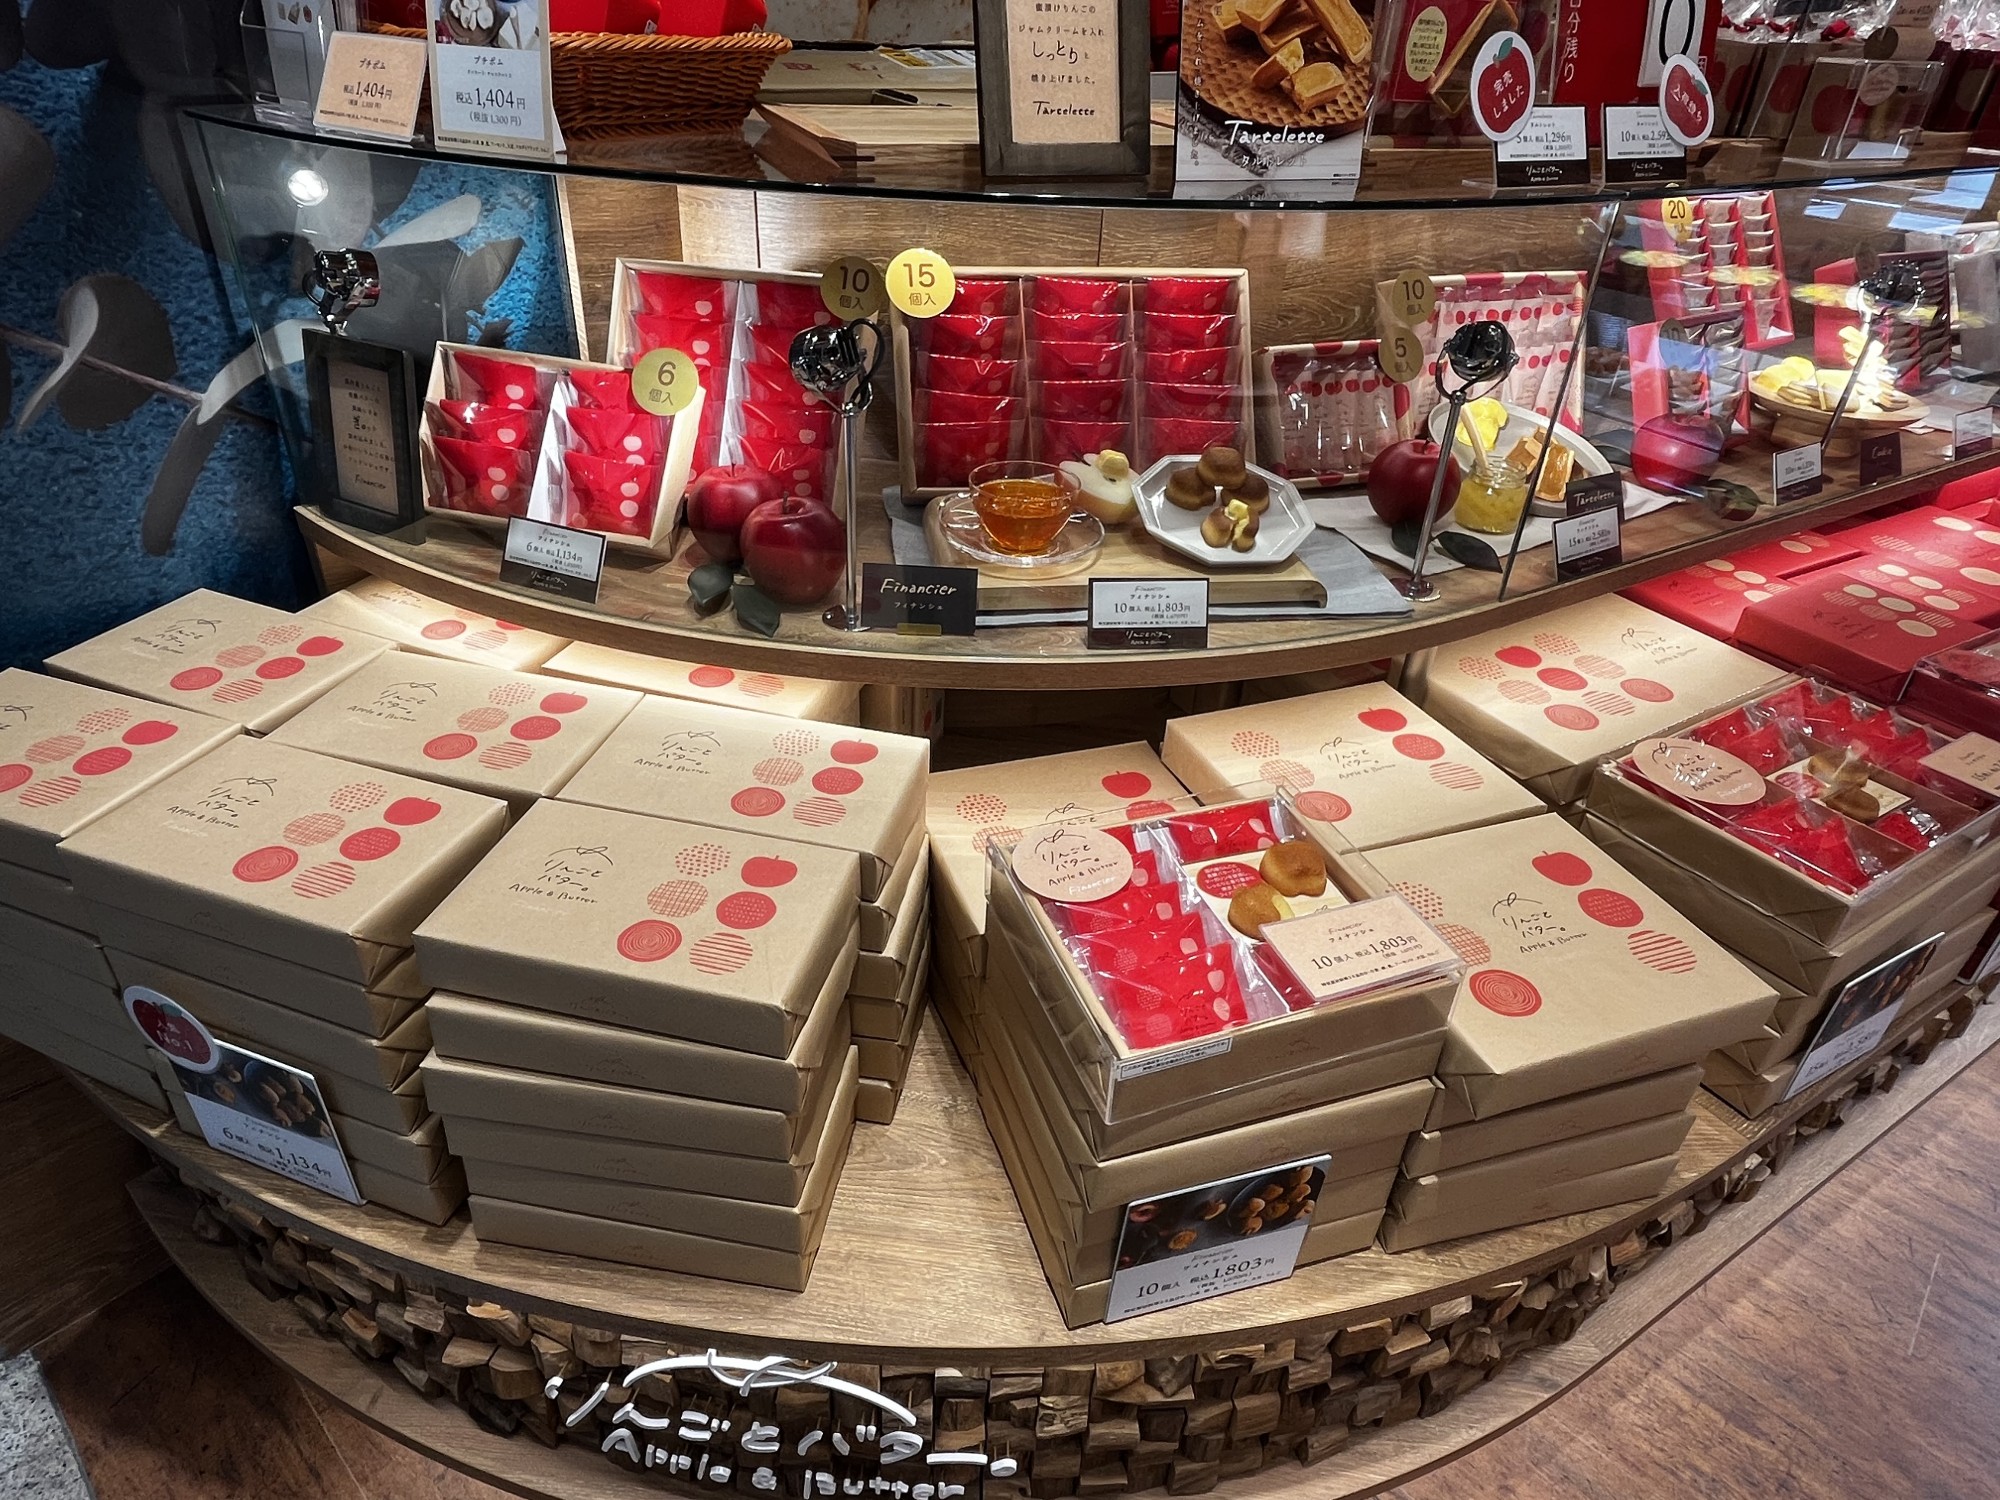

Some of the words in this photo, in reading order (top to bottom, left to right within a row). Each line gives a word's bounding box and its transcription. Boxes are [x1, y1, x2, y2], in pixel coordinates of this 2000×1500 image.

[1493, 70, 1513, 96] 完売
[1493, 85, 1525, 118] しました
[1225, 119, 1325, 146] Tartelette
[1668, 200, 1686, 219] 20
[839, 265, 870, 293] 10
[902, 263, 935, 288] 15
[908, 291, 937, 307] 個入
[1403, 279, 1425, 300] 10
[839, 294, 864, 311] 個入
[1394, 337, 1407, 358] 5
[656, 361, 676, 387] 6
[648, 388, 674, 406] 個入
[880, 577, 957, 596] Financier
[894, 601, 943, 610] フィナンシェ
[508, 883, 544, 895] Apple
[1311, 953, 1354, 970] 10個入
[1355, 935, 1418, 958] 税込1,803円
[602, 1428, 732, 1484] Apple
[751, 1466, 778, 1491] &
[803, 1469, 965, 1500] Butter
